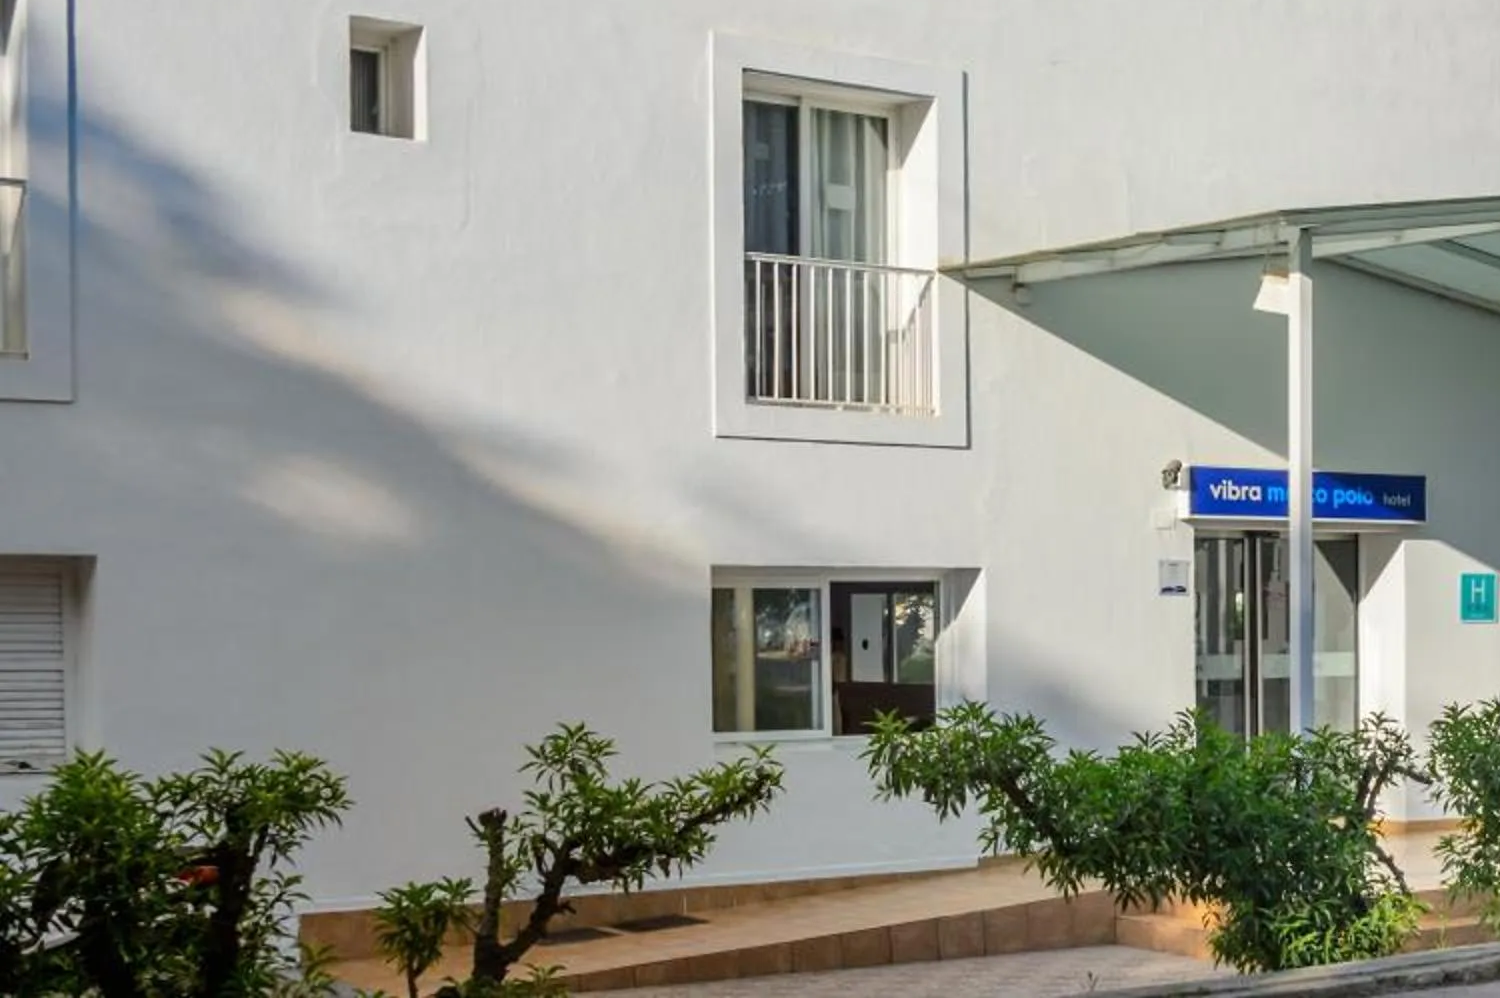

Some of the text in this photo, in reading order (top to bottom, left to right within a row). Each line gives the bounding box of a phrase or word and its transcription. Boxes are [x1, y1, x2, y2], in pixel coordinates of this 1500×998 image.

[1209, 479, 1262, 501] vibra
[1383, 492, 1411, 507] hotel
[1471, 578, 1486, 603] H
